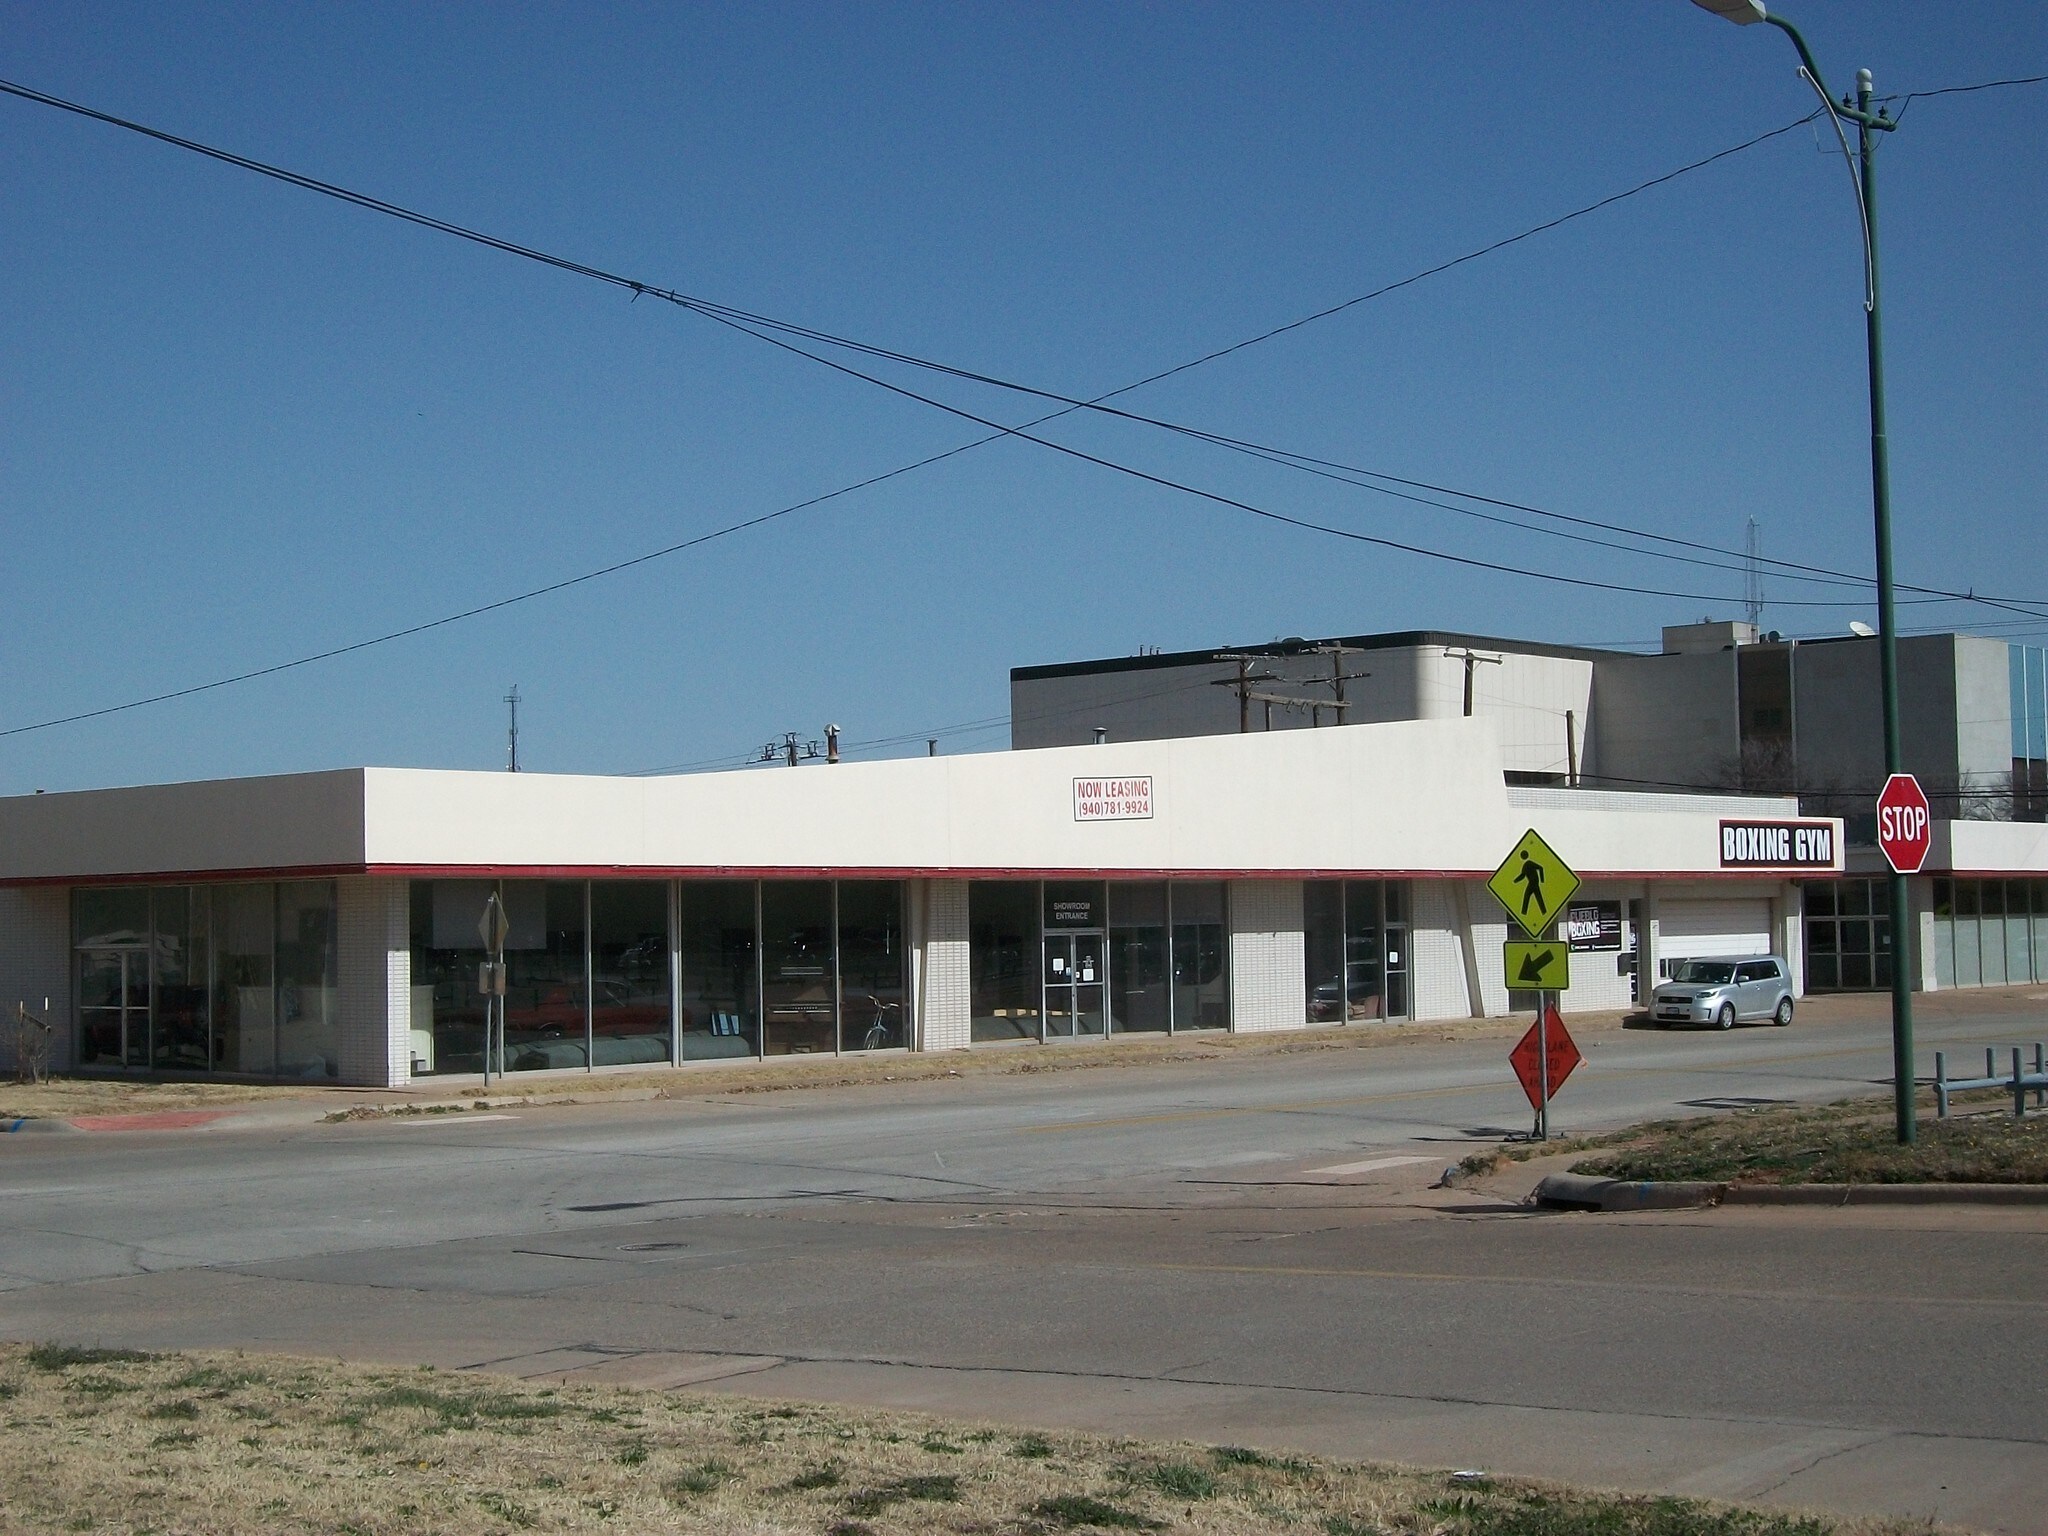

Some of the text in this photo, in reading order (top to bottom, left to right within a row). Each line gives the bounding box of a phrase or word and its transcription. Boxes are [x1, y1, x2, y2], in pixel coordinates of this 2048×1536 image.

[1078, 780, 1148, 798] NOW LEASING
[1079, 800, 1148, 817] (940)781-9924
[1882, 805, 1926, 841] STOP
[1723, 827, 1831, 861] BOXING GYM
[1053, 902, 1091, 910] SHOWROOM
[1056, 912, 1088, 920] ENTRANCE
[1571, 921, 1600, 937] BOXING
[1528, 1058, 1560, 1071] CLED
